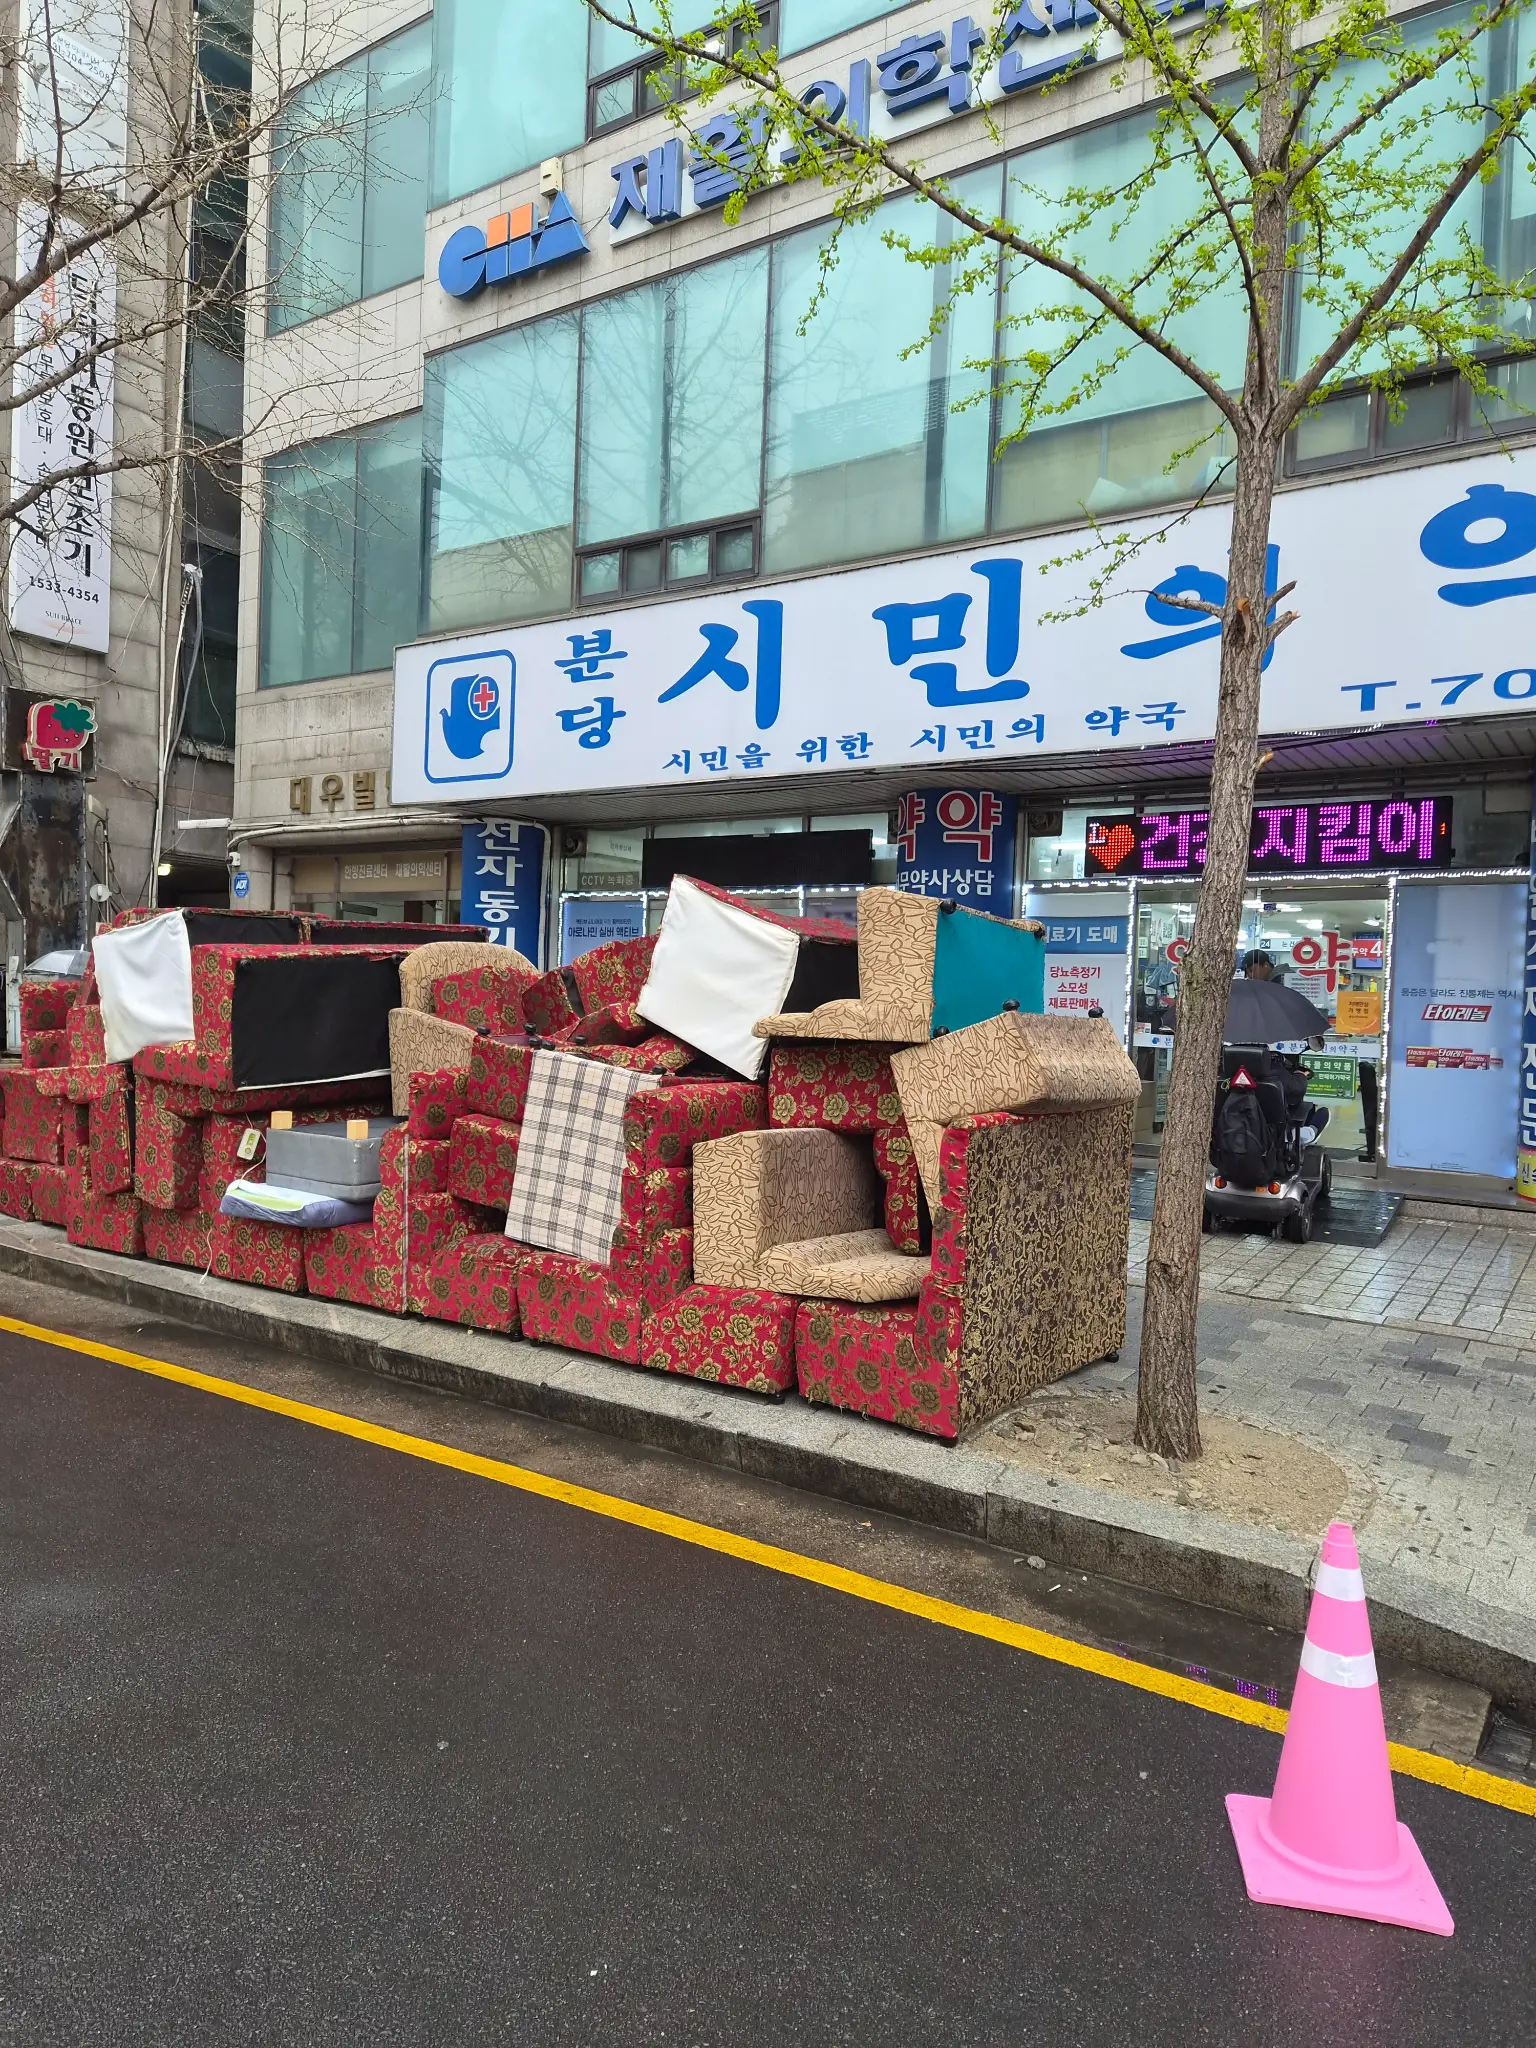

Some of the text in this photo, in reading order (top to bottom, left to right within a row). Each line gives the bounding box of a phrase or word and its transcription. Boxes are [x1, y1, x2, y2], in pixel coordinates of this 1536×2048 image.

[29, 576, 99, 604] 1533-4354
[663, 701, 1185, 775] 시민을 위한 시민의 약국
[31, 747, 78, 769] 딸기
[289, 771, 391, 815] 대우빌
[936, 790, 1002, 863] 약
[344, 861, 442, 880] 한방진료센터 재활의학센터
[581, 875, 605, 886] CCTV
[1086, 925, 1119, 944] 도매
[1291, 930, 1352, 994] 약
[1050, 966, 1101, 979] 당뇨측정기
[1057, 982, 1088, 995] 소모성
[1497, 990, 1517, 999] 역시
[1424, 1004, 1487, 1021] 타이레놀
